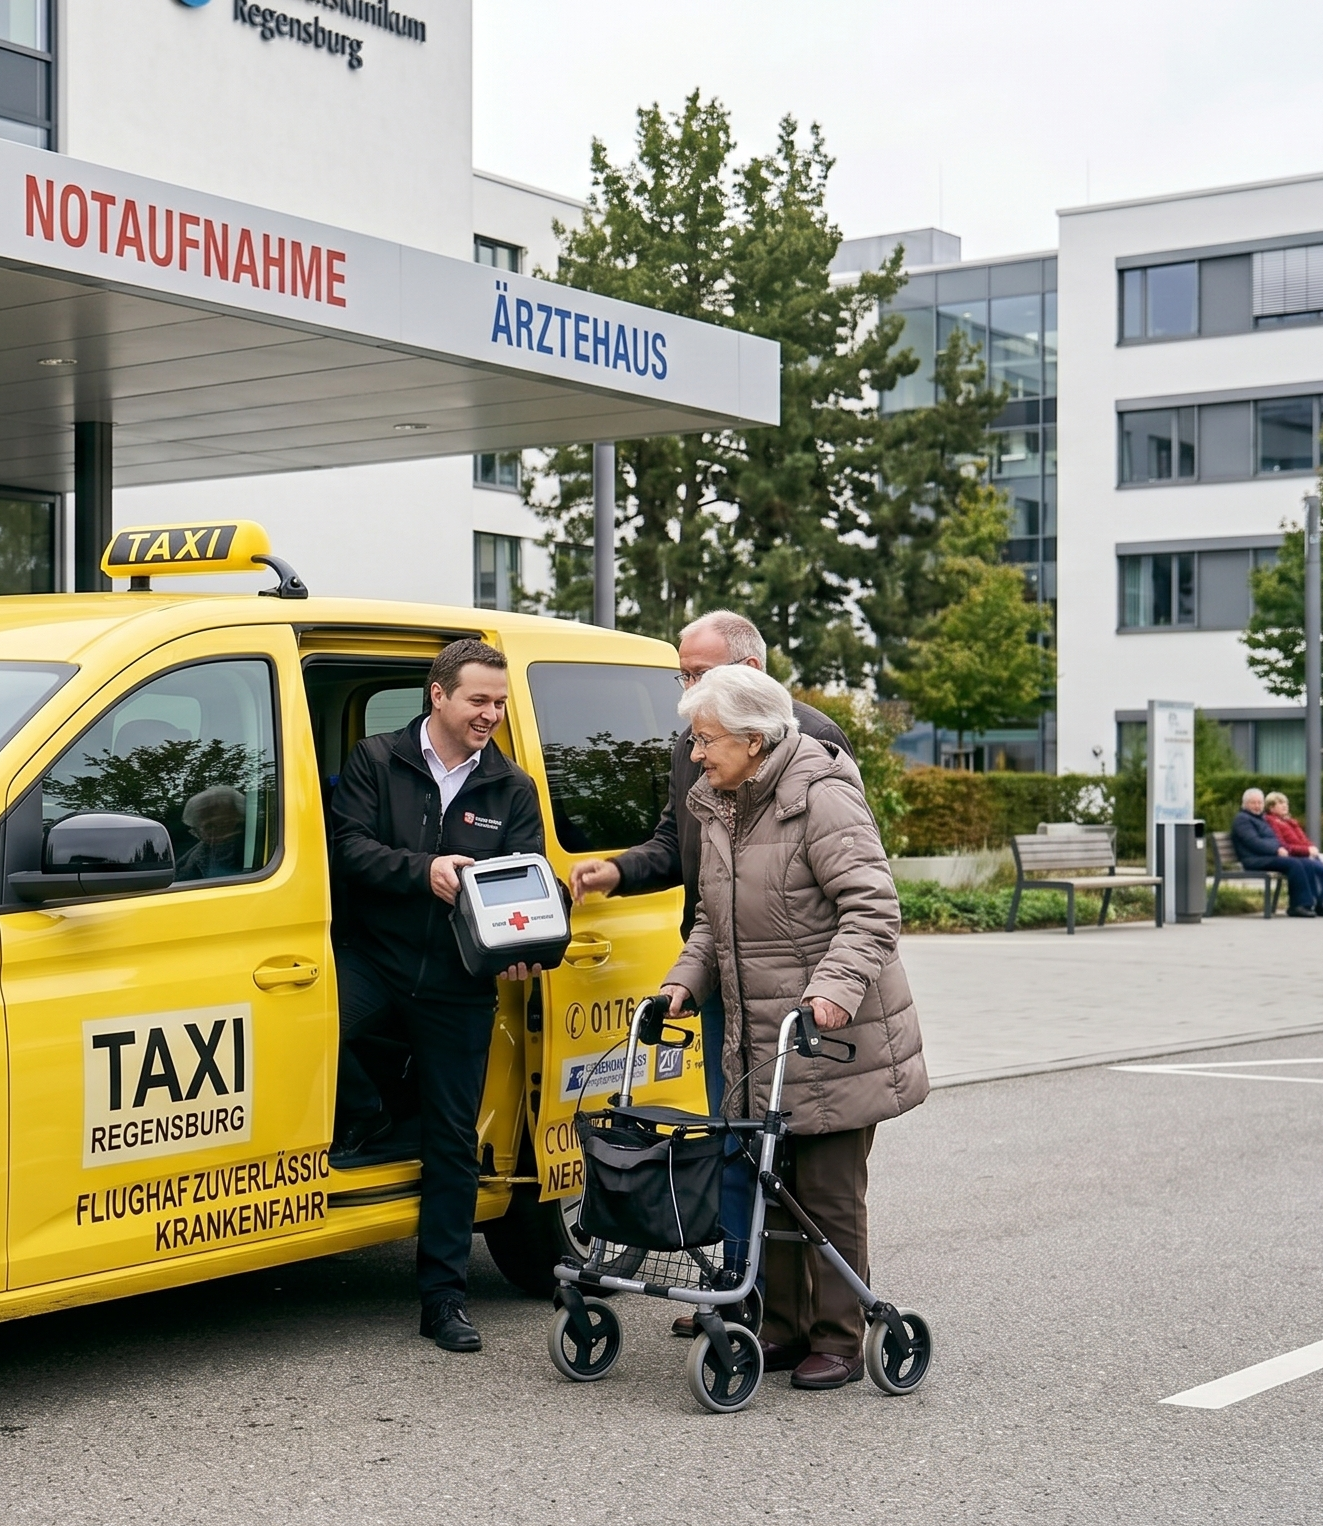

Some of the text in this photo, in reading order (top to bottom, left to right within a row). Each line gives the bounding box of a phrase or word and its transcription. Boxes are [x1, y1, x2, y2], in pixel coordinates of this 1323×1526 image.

[233, 0, 363, 70] Regensburg
[26, 174, 346, 308] NOTAUFNAHME
[491, 280, 668, 380] ÄRZTEHAUS
[128, 528, 222, 562] TAXI
[92, 1017, 245, 1111] TAXI
[91, 1105, 245, 1153] REGENSBURG
[76, 1175, 190, 1226] FLIUGHAF
[548, 1160, 583, 1193] NER
[156, 1191, 325, 1251] KRANKENFAHR
